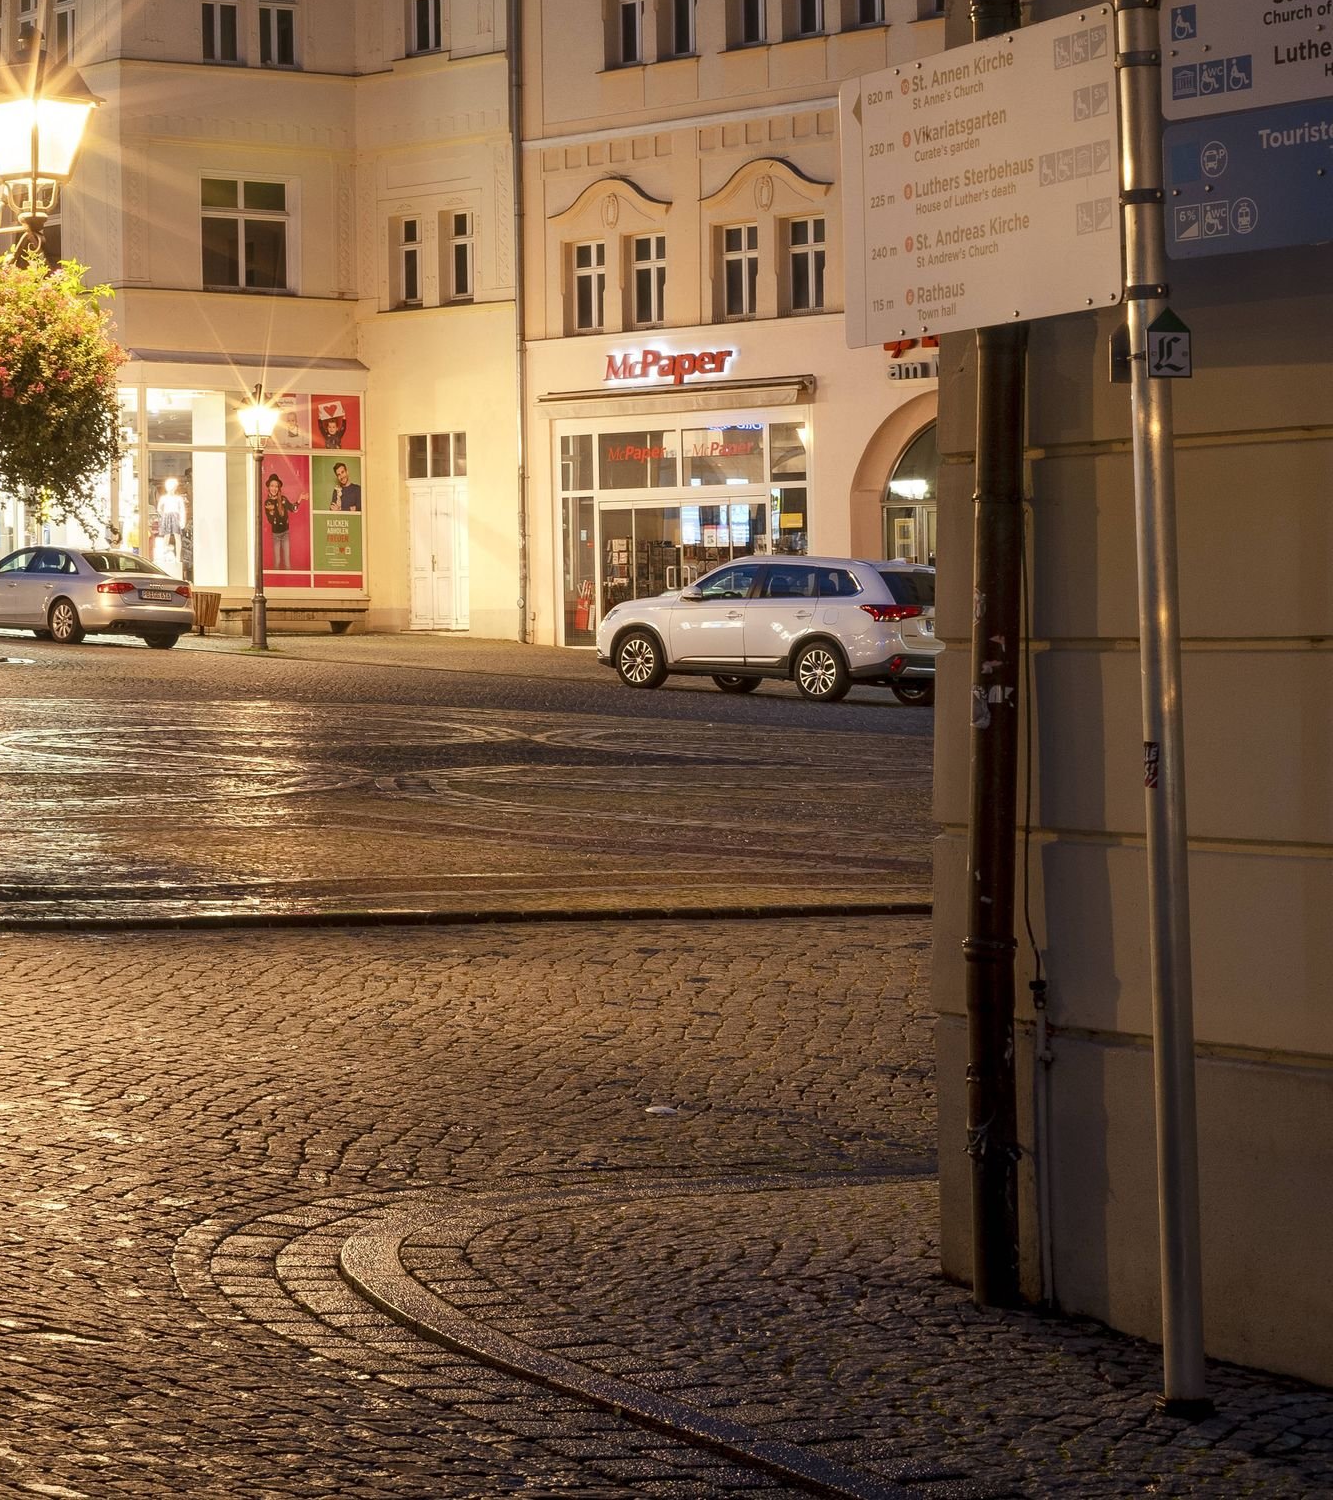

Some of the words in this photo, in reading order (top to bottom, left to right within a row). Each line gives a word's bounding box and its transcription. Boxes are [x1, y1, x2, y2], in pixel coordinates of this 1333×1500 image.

[1263, 4, 1312, 26] Church
[1317, 0, 1332, 14] of
[912, 76, 928, 93] St.
[931, 66, 970, 88] Annen
[974, 51, 1014, 75] Kirche
[1208, 66, 1223, 76] WC
[867, 91, 883, 106] 820
[885, 90, 893, 100] m
[913, 98, 922, 110] St
[924, 89, 951, 108] Anne's
[954, 81, 984, 99] Church
[913, 109, 1007, 145] Vikariatsgarten
[869, 144, 885, 157] 230
[887, 141, 895, 152] m
[914, 145, 948, 163] Curate's
[950, 138, 980, 156] garden
[915, 178, 960, 198] Luthers
[964, 157, 1034, 187] Sterbehaus
[870, 196, 885, 209] 225
[887, 195, 895, 204] m
[916, 200, 941, 215] House
[944, 194, 952, 208] of
[955, 187, 989, 206] Luther's
[991, 182, 1016, 198] death
[1211, 208, 1226, 218] WC
[916, 233, 932, 251] St.
[935, 220, 986, 247] Andreas
[989, 212, 1030, 236] Kirche
[872, 249, 887, 261] 240
[889, 246, 897, 256] m
[916, 255, 925, 268] St
[928, 248, 966, 266] Andrew's
[968, 241, 999, 259] Church
[917, 282, 965, 304] Rathaus
[873, 300, 884, 313] 115
[886, 300, 894, 310] m
[918, 307, 939, 321] Town
[941, 303, 957, 316] hall
[603, 349, 733, 385] McPaper
[887, 362, 922, 380] am
[608, 445, 666, 463] McPaper
[693, 440, 753, 457] McPaper
